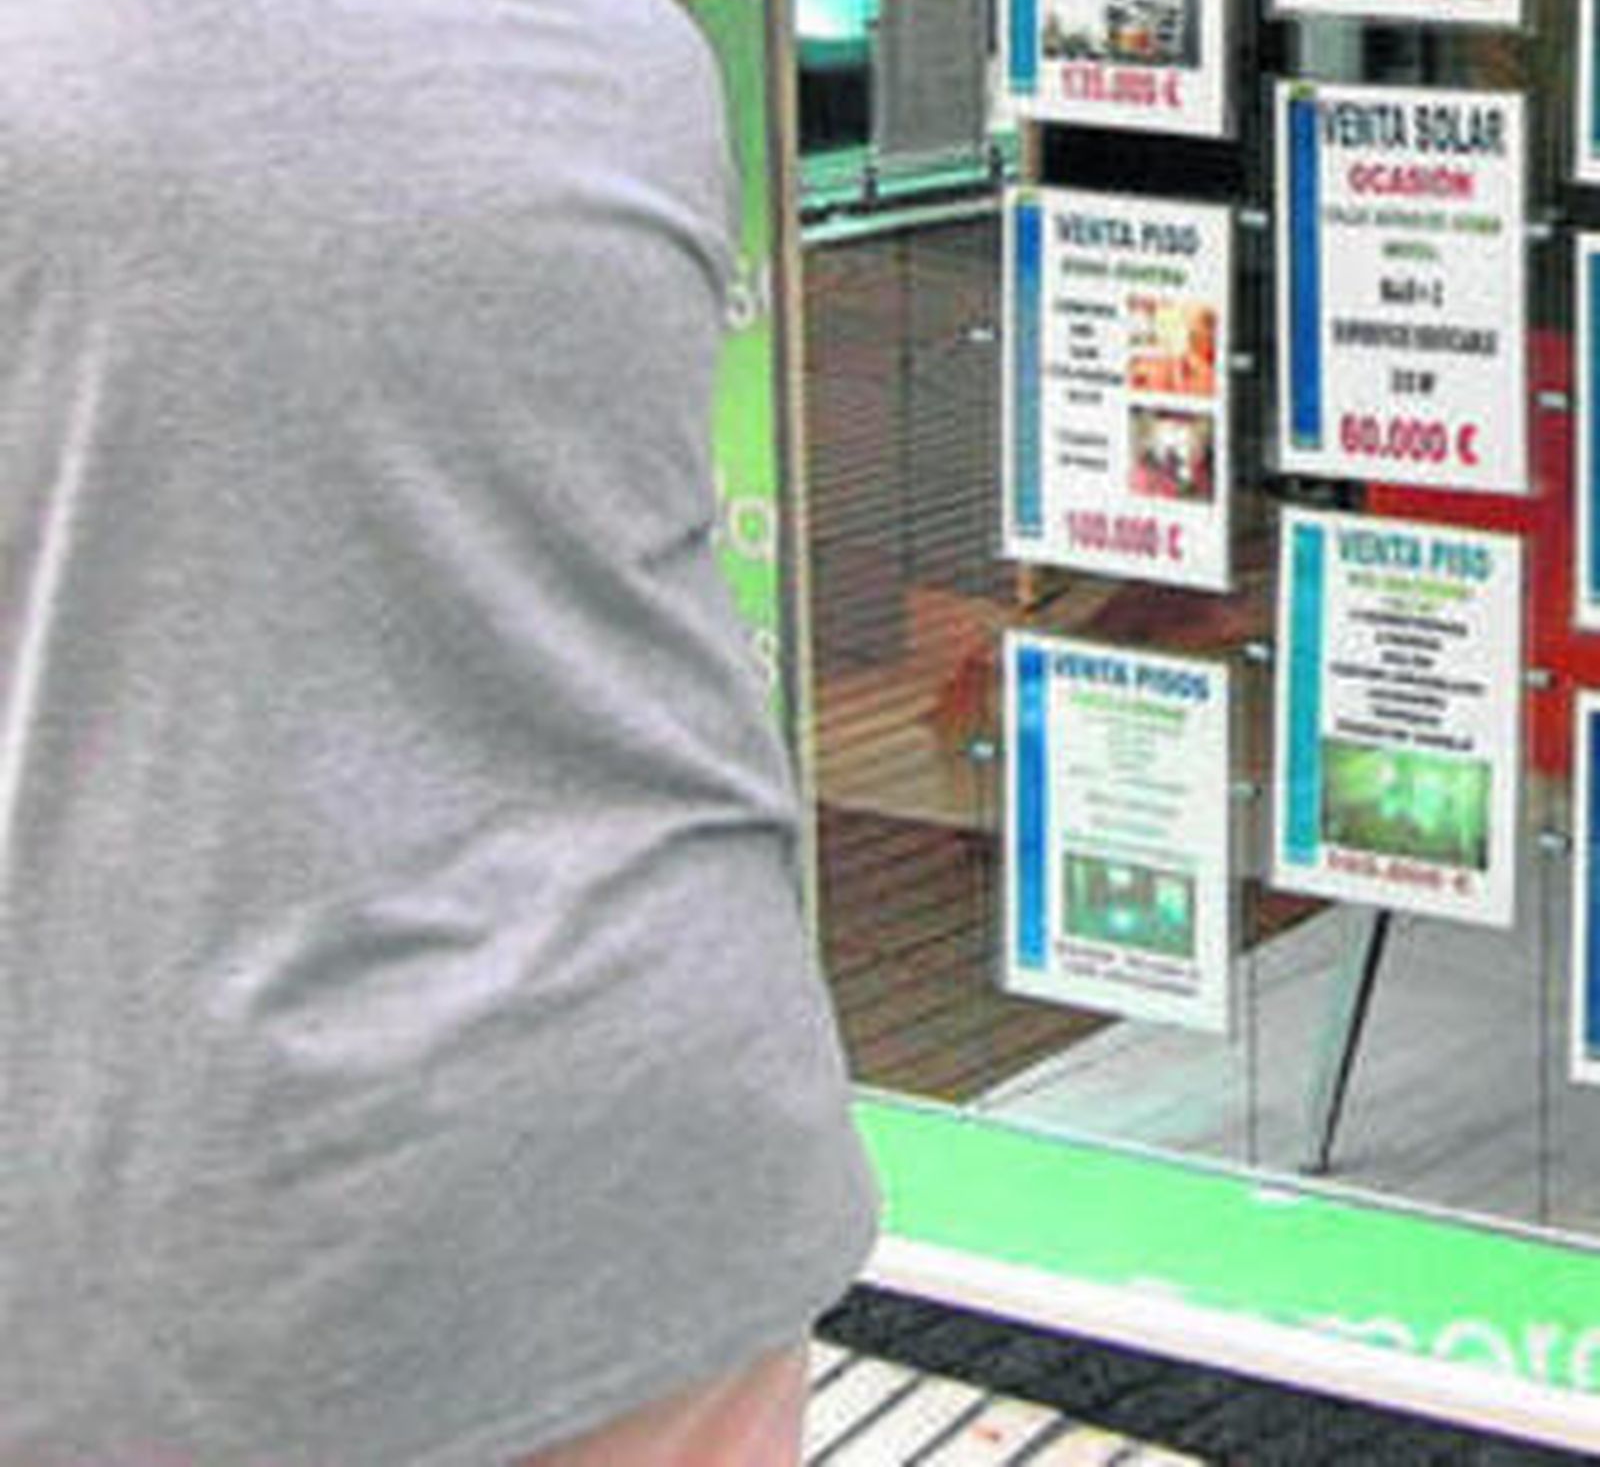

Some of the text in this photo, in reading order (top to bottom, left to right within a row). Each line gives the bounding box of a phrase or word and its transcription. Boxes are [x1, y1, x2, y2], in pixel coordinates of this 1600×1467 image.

[1323, 102, 1505, 158] VENTA SOLAR
[1055, 214, 1200, 257] VENTA PISO
[1339, 414, 1480, 467] 60.000 €
[1338, 529, 1492, 583] VENTA PISO
[1053, 651, 1210, 703] VENTA PISOS
